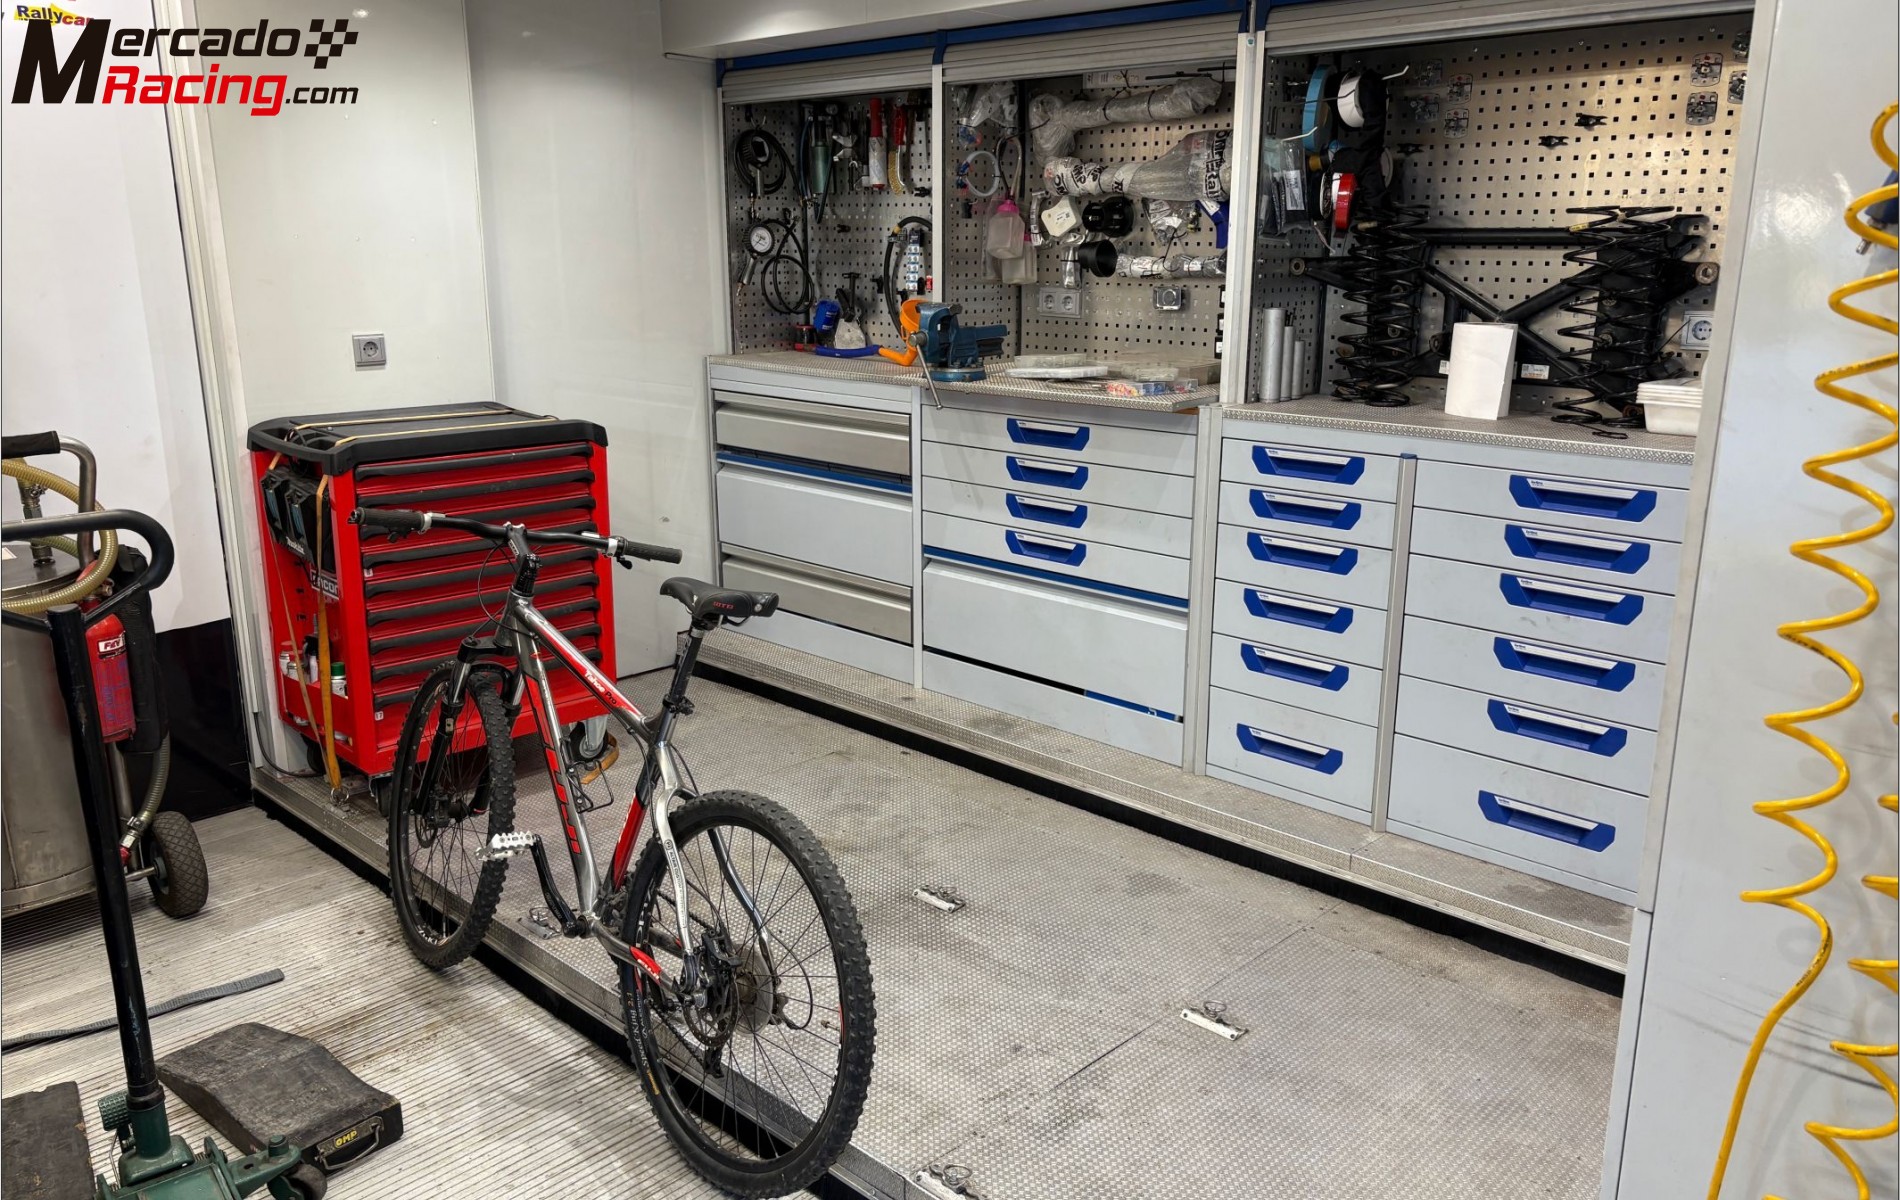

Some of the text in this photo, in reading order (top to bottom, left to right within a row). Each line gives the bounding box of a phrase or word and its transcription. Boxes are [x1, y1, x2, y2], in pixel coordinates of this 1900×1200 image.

[585, 669, 617, 704] Tahoe Pro
[335, 1130, 358, 1146] OMP
